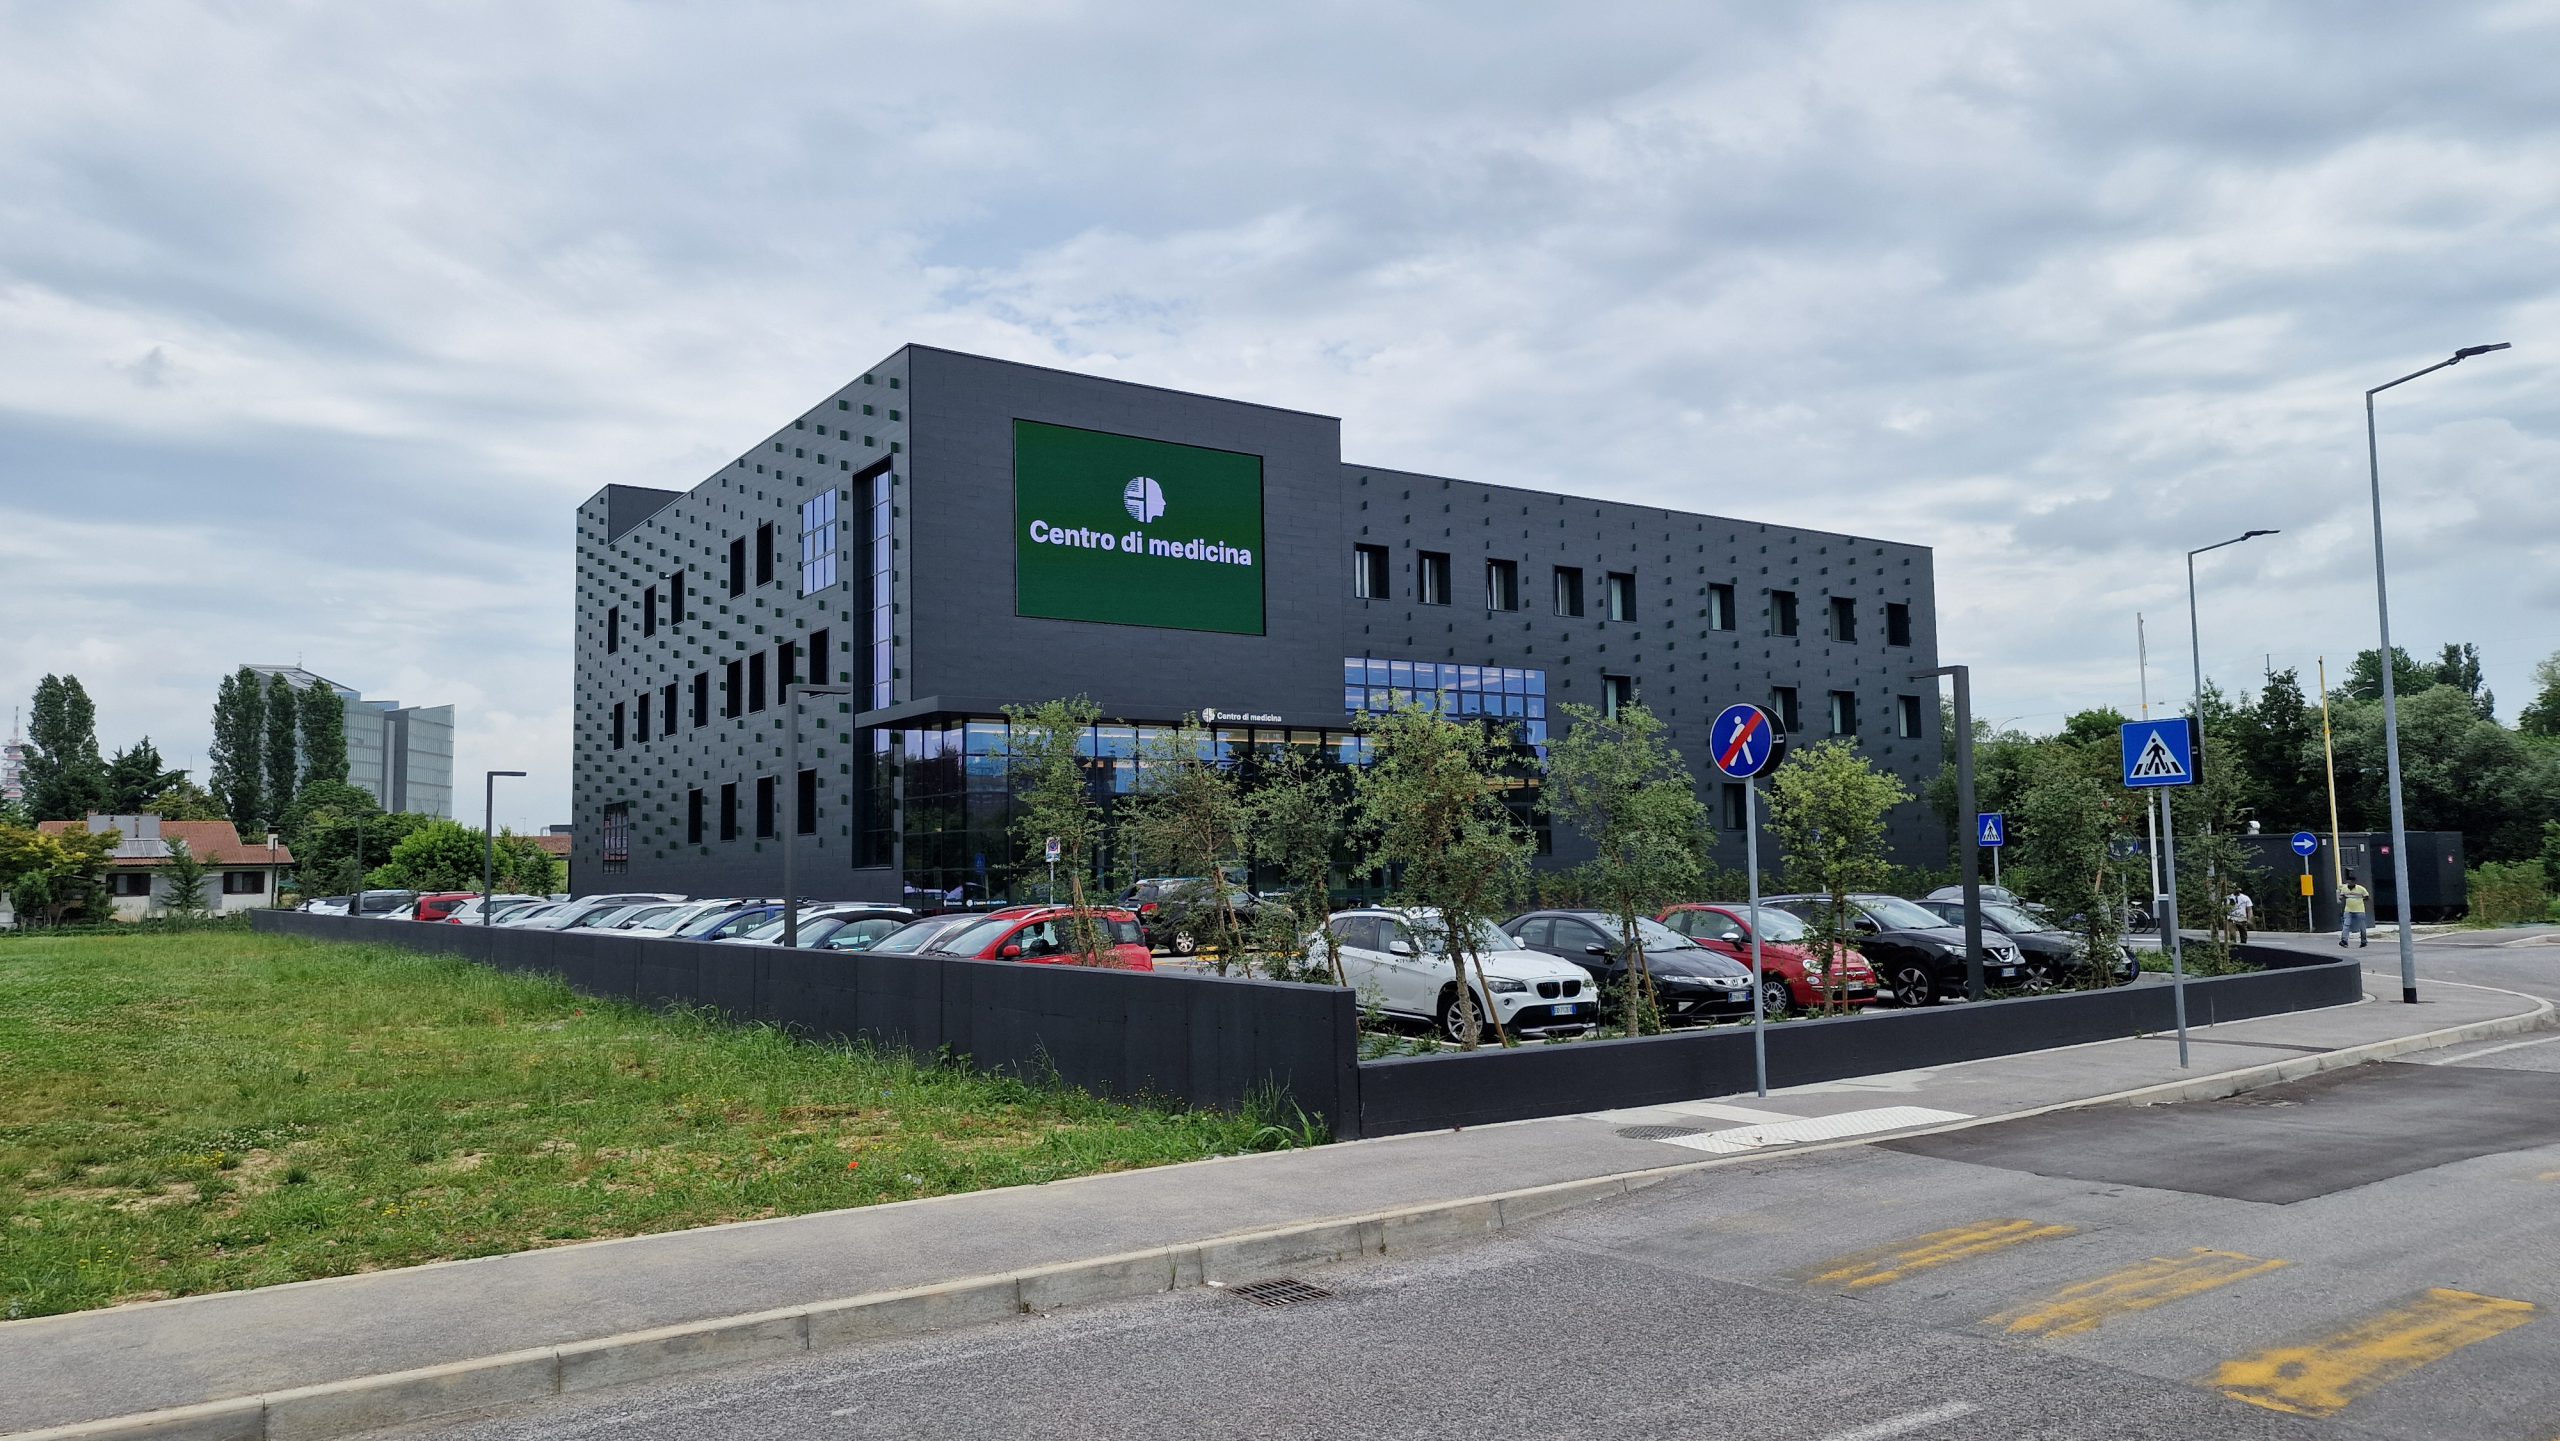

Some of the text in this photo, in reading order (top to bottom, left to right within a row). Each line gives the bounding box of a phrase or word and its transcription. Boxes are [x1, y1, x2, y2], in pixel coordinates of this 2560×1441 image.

[1029, 519, 1253, 566] Centro di medicina
[1216, 711, 1282, 723] Centro di medicina
